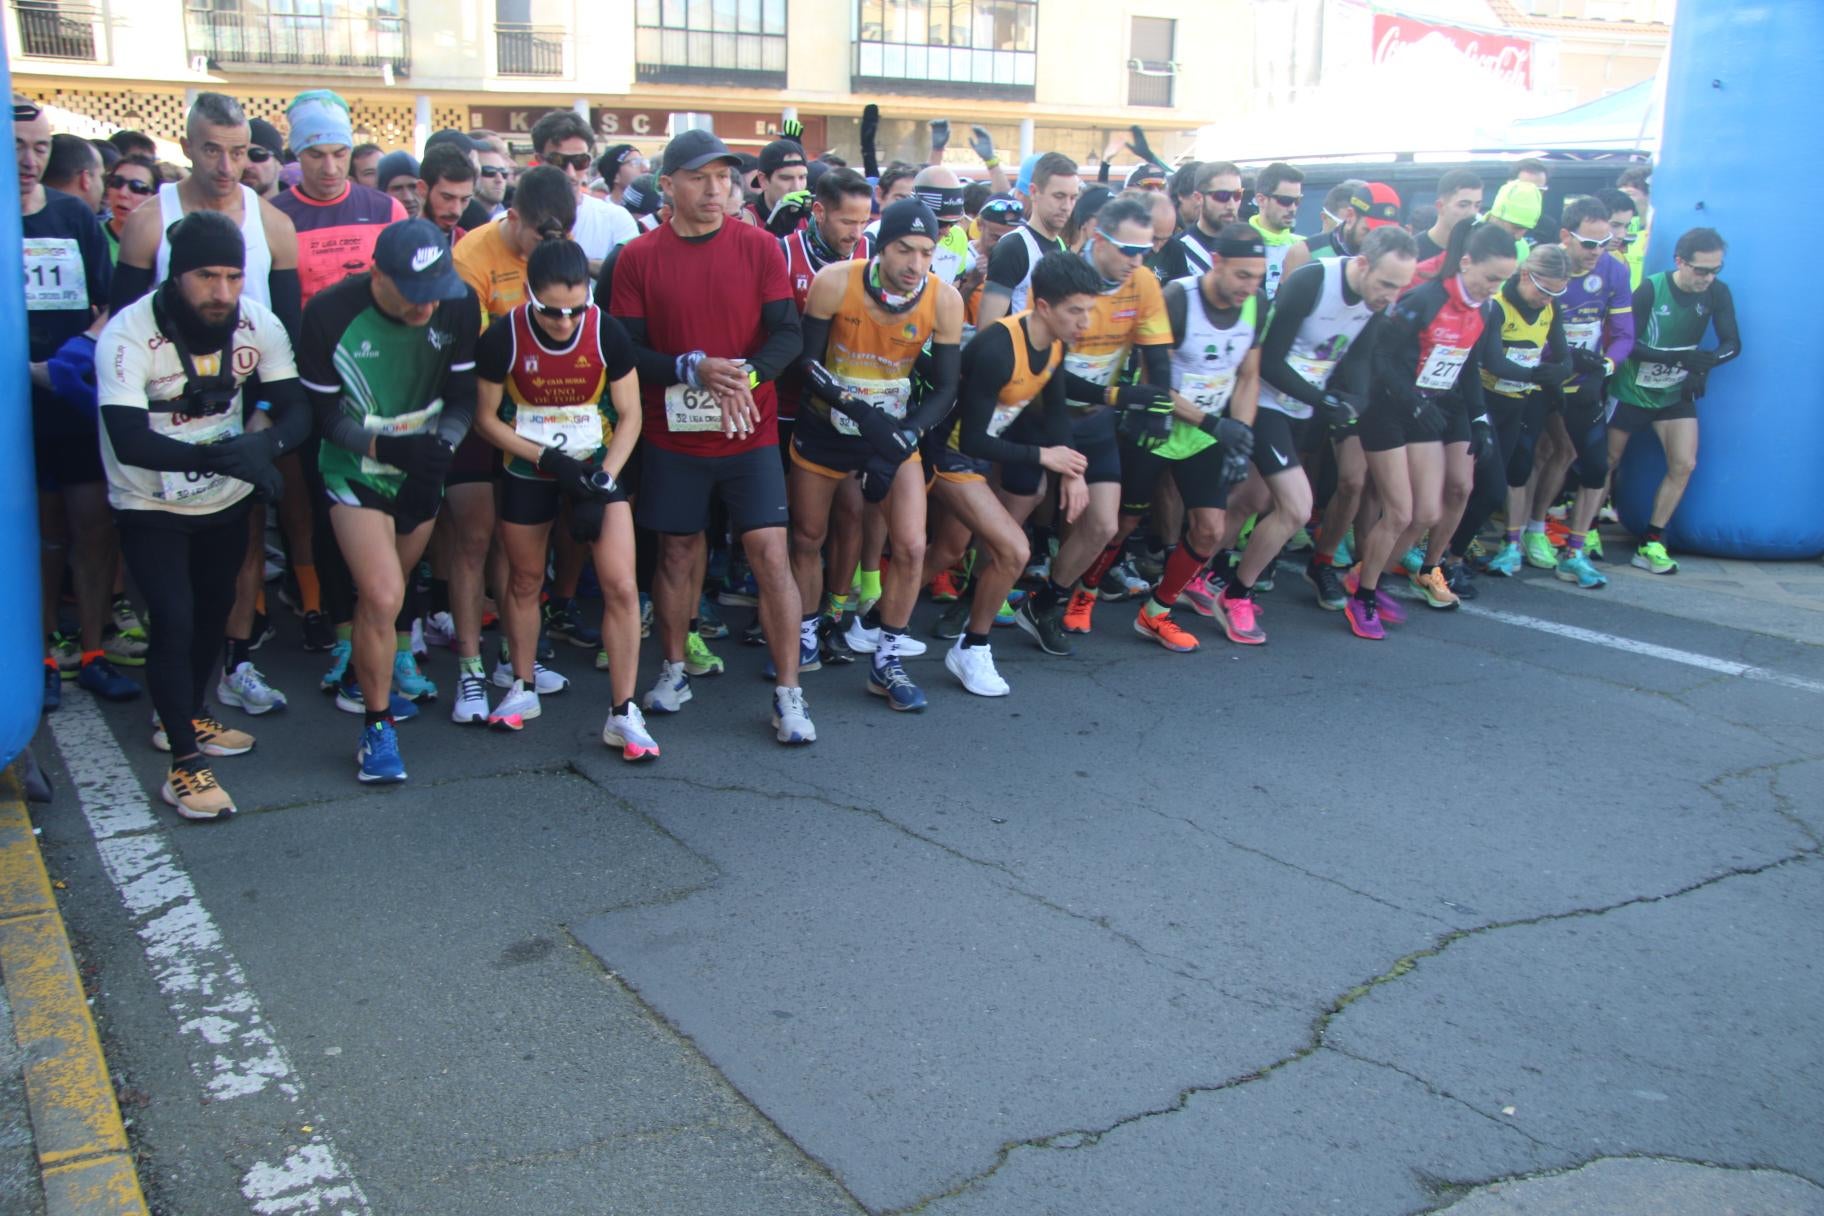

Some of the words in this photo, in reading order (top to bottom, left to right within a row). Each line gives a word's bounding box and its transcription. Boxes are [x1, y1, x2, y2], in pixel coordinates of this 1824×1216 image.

[544, 387, 576, 396] VINO
[535, 395, 549, 403] DE
[554, 394, 586, 403] TORO
[682, 388, 722, 410] 62
[676, 413, 687, 423] 32
[552, 432, 568, 453] 2
